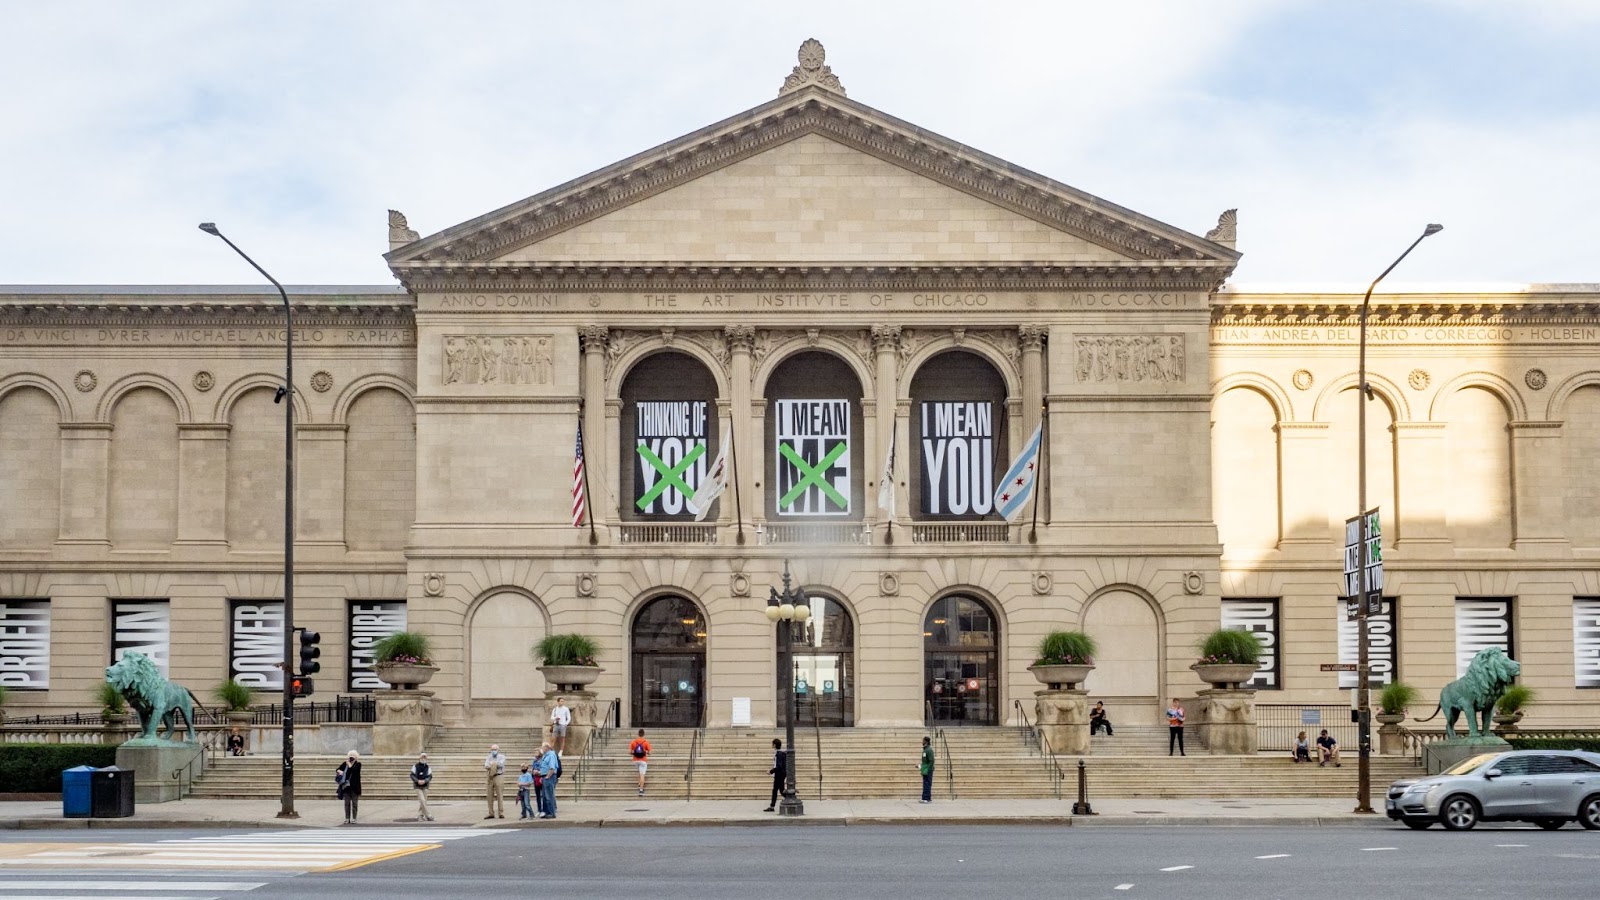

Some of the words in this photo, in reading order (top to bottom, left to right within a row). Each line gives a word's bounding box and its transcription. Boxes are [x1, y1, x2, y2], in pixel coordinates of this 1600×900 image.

[440, 294, 487, 307] ANNO
[496, 294, 558, 307] DOMINI
[644, 294, 677, 307] THE
[702, 294, 735, 307] ART
[757, 294, 849, 307] INSTITVTE
[870, 294, 893, 307] OF
[913, 294, 988, 307] CHICAGO
[7, 329, 26, 342] DA
[33, 329, 76, 342] VINCI
[98, 330, 151, 342] DVRER
[173, 330, 247, 342] MICHAEL
[1263, 329, 1320, 341] ANDREA
[1327, 329, 1356, 341] DEL
[1363, 329, 1409, 341] SARTO
[1425, 328, 1513, 341] CORREGGIO
[1530, 328, 1596, 340] HOLBEIN
[636, 402, 691, 437] THINKING
[693, 402, 707, 437] OF
[779, 402, 785, 436] I
[791, 402, 847, 436] MEAN
[922, 402, 928, 437] I
[935, 402, 991, 437] MEAN
[637, 437, 708, 515] YOU
[779, 438, 848, 514] ME
[922, 438, 992, 515] YOU
[0, 602, 50, 687] PROFIT
[115, 603, 170, 681] AIN
[232, 605, 285, 691] POWER
